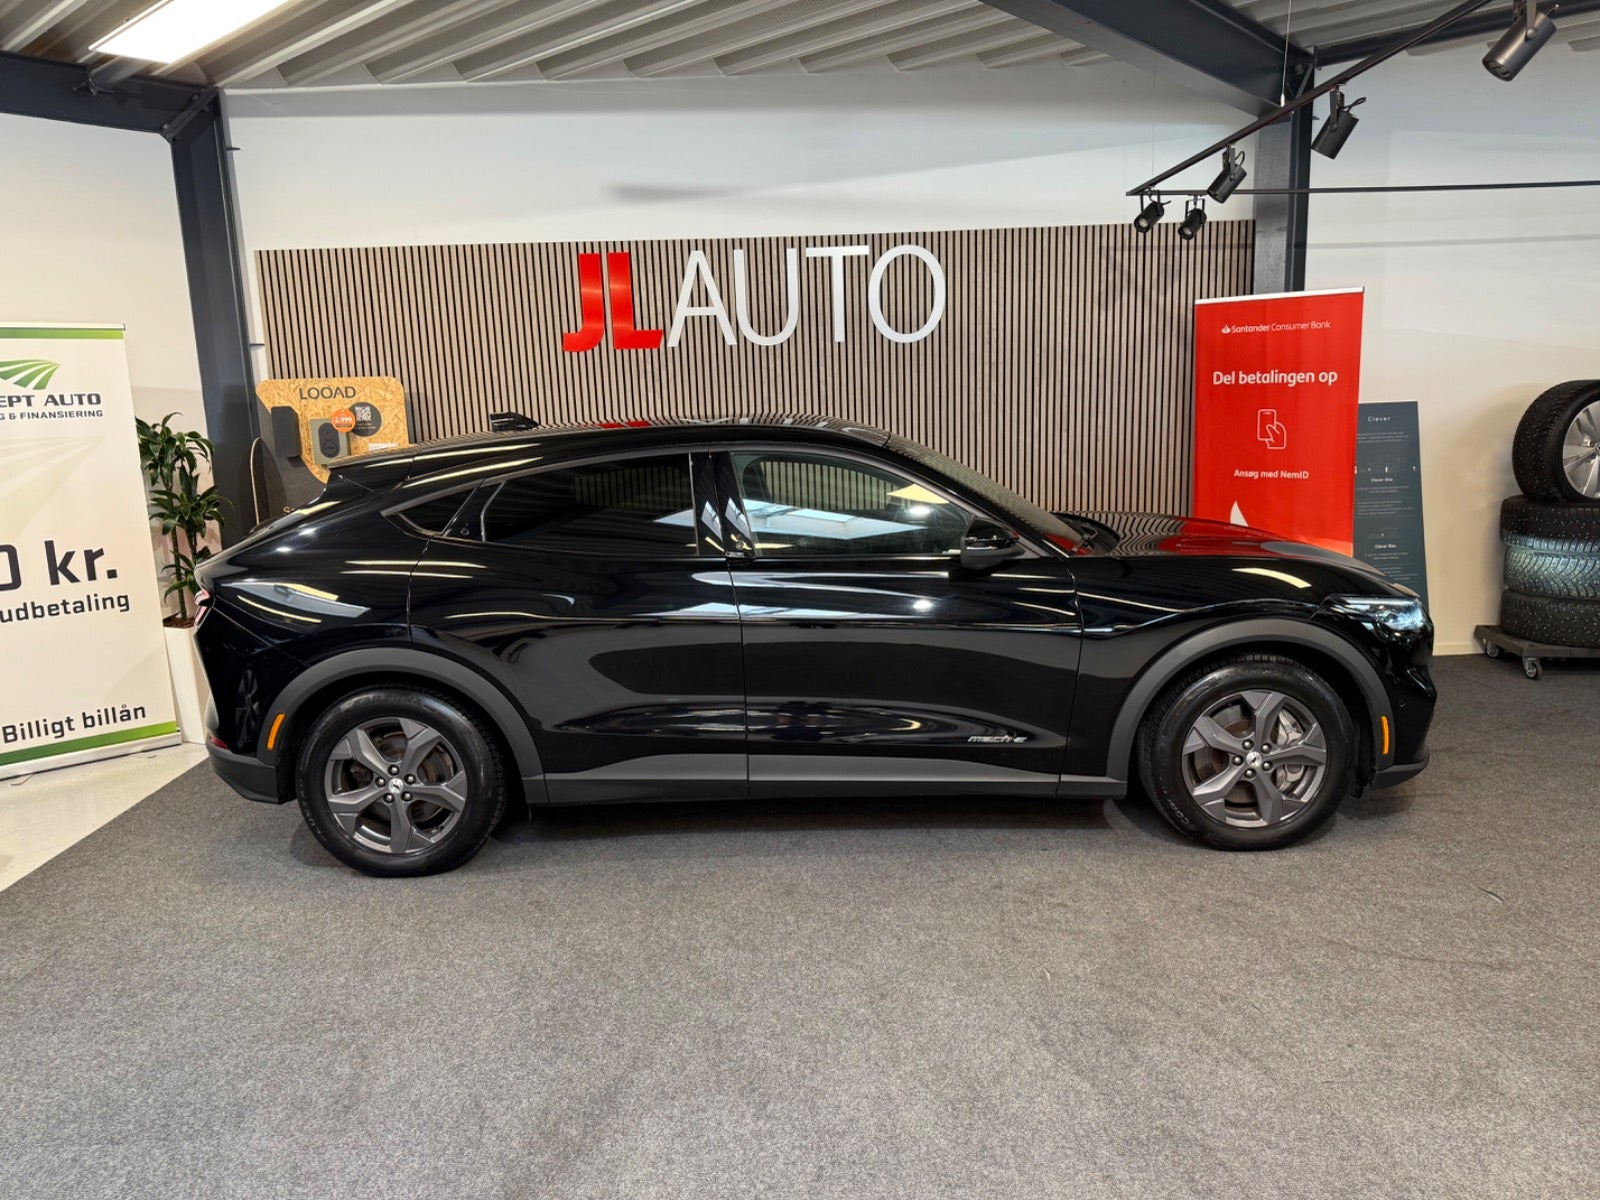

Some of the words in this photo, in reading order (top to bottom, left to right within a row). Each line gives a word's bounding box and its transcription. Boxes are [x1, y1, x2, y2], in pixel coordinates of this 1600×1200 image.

[667, 244, 946, 347] AUTO
[1231, 324, 1270, 334] Santander
[1271, 322, 1310, 332] Consumer
[1311, 320, 1331, 329] Bank
[1212, 370, 1236, 385] Del
[1238, 369, 1315, 387] betalingen
[1318, 371, 1338, 386] op
[44, 393, 102, 407] AUTO
[299, 386, 357, 400] LOOAD
[9, 412, 16, 420] &
[20, 409, 103, 420] FINANSIERING
[1233, 469, 1259, 480] Ansøg
[1260, 470, 1279, 478] med
[1280, 470, 1309, 480] NemID
[44, 540, 118, 586] kr.
[0, 593, 130, 623] udbetaling
[2, 715, 75, 744] Billigt
[82, 704, 146, 729] billån
